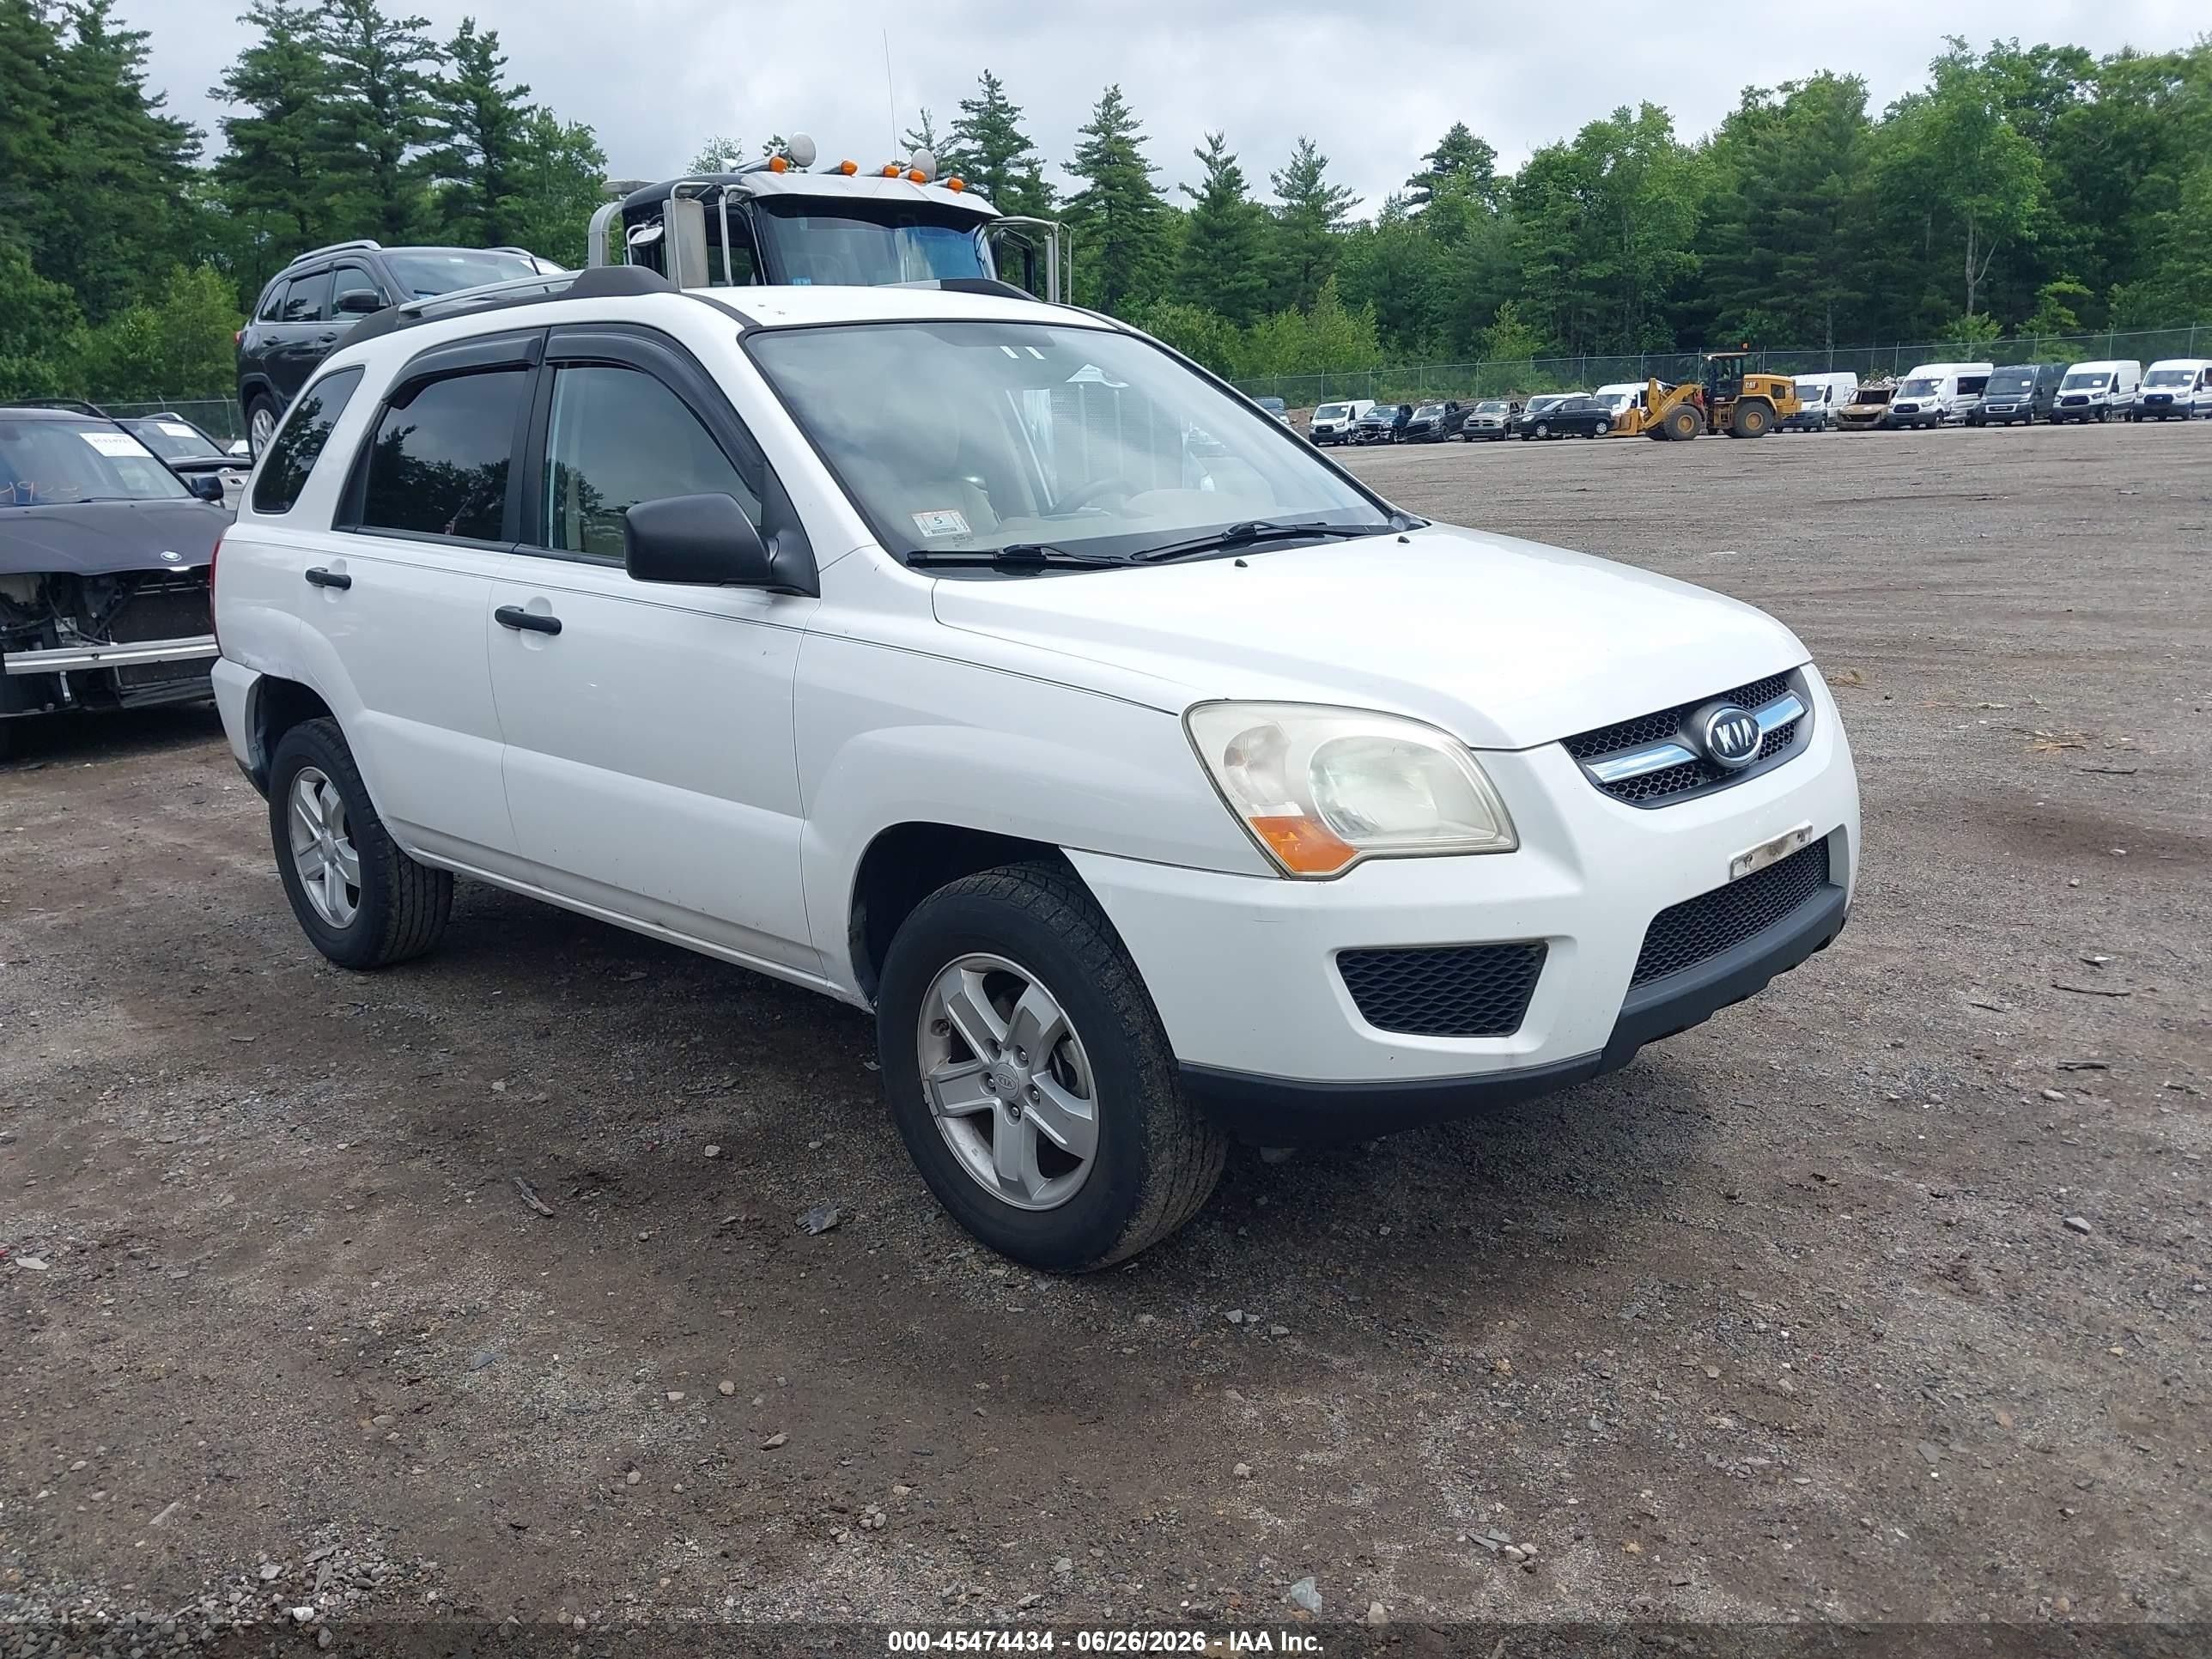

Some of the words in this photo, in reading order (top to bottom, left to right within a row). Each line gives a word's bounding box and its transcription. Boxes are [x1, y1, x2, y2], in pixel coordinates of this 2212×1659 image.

[1745, 380, 1756, 389] CAT
[933, 516, 943, 525] 5
[1715, 718, 1756, 754] KIA
[998, 1075, 1013, 1088] KIA
